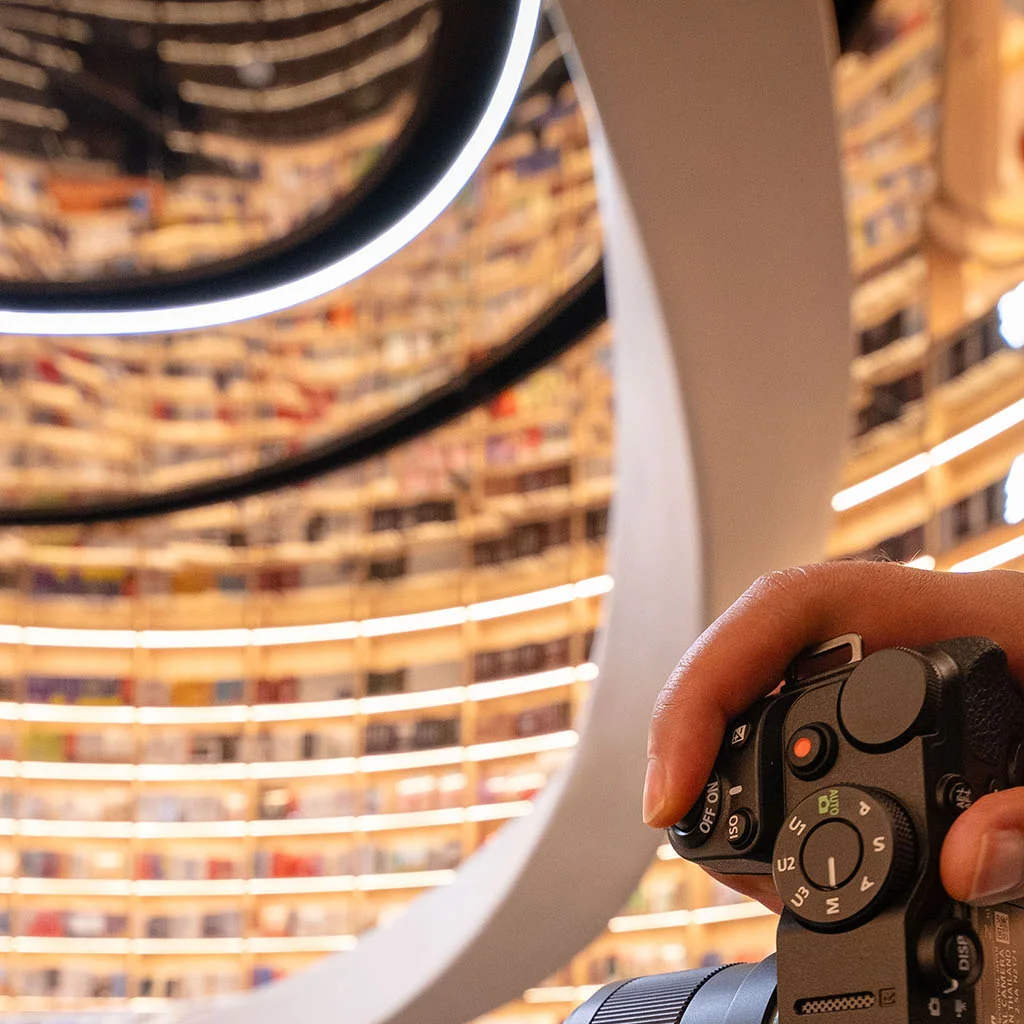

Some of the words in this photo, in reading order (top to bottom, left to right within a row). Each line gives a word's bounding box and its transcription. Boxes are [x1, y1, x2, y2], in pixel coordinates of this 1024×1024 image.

[699, 805, 715, 835] OFF
[707, 780, 719, 805] ON
[828, 789, 840, 817] AUTO
[858, 801, 872, 816] P
[727, 815, 739, 840] ISO
[788, 816, 806, 836] U1
[872, 836, 886, 851] S
[777, 856, 796, 872] U2
[859, 875, 875, 892] A
[790, 886, 811, 908] U3
[825, 897, 840, 915] M
[958, 935, 969, 972] DISP
[999, 949, 1008, 1008] CAMERA
[1005, 949, 1014, 1011] THAILAND
